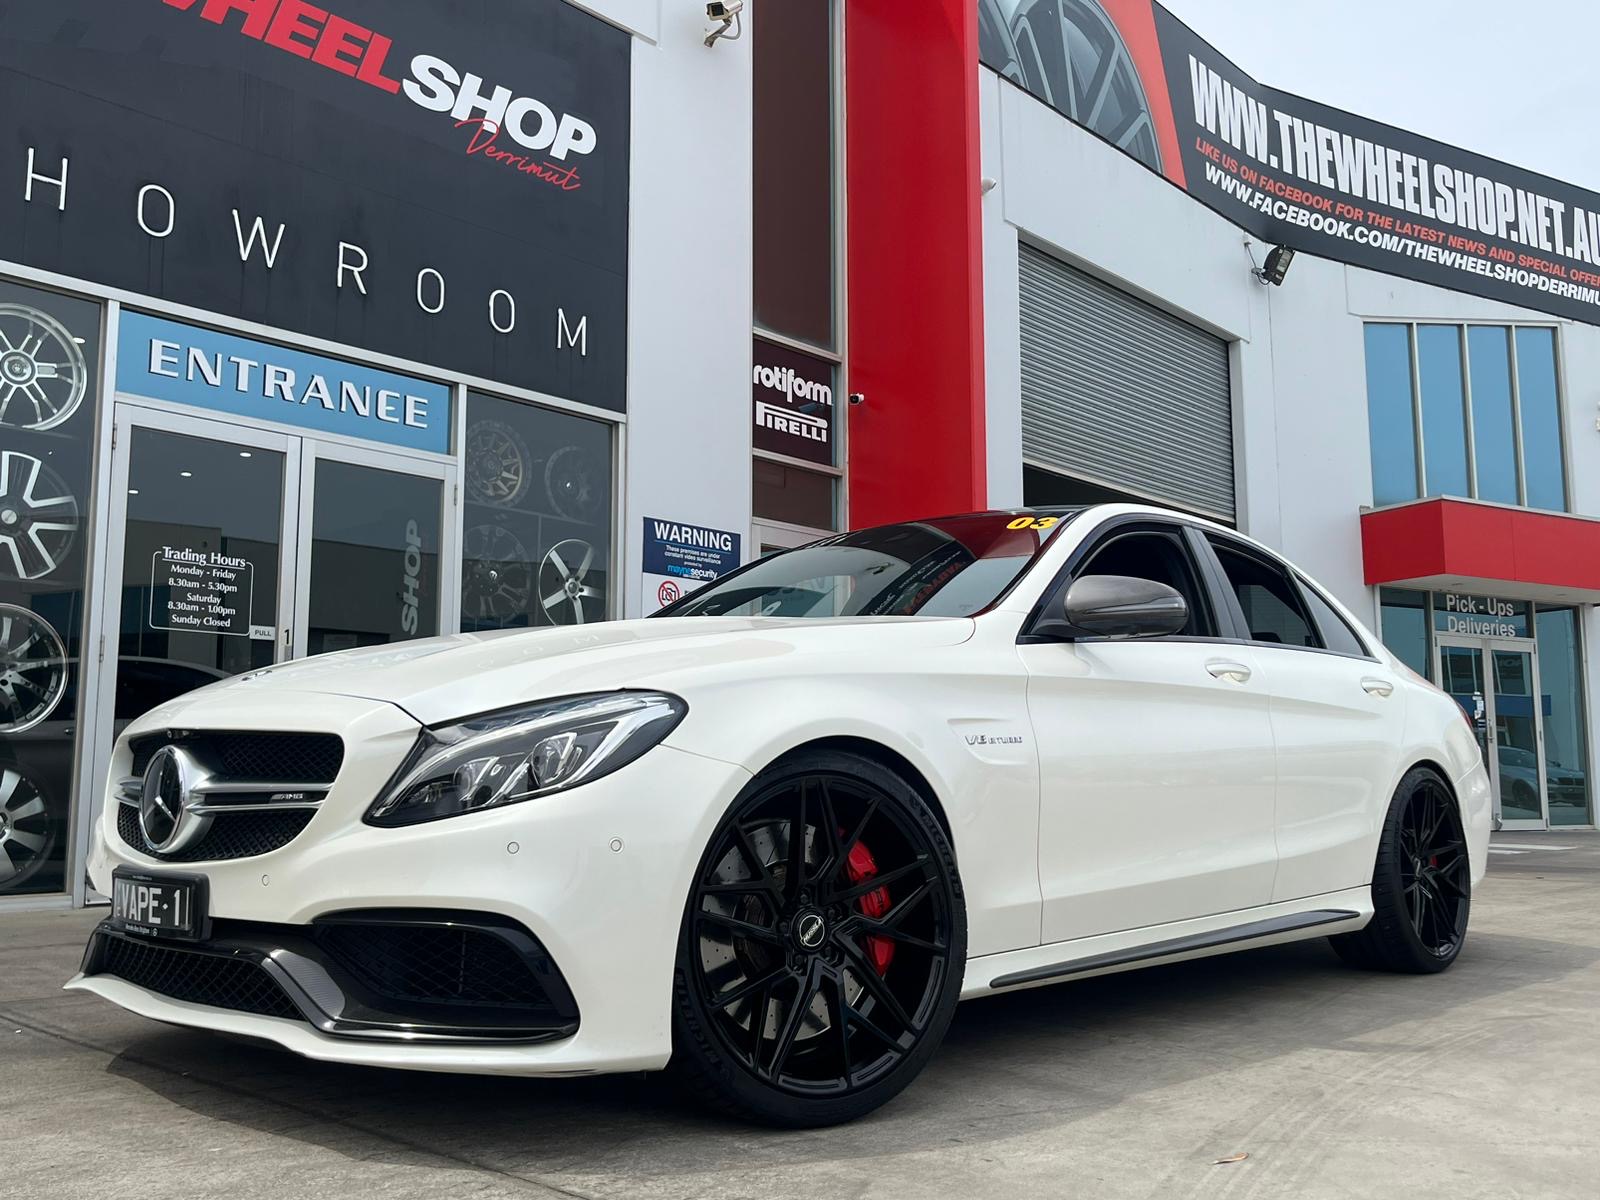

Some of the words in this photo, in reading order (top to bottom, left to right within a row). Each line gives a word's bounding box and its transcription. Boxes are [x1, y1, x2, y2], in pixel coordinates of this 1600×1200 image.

[454, 118, 580, 190] Derrimut
[1196, 137, 1220, 162] LIKE
[1221, 154, 1238, 174] US
[1240, 165, 1258, 185] ON
[1259, 175, 1333, 214] FACEBOOK
[1335, 202, 1364, 222] FOR
[1367, 211, 1394, 230] THE
[1395, 220, 1446, 244] LATEST
[1447, 234, 1487, 256] NEWS
[1488, 246, 1516, 263] AND
[1518, 254, 1568, 278] SPECIAL
[149, 338, 429, 428] ENTRANCE
[753, 364, 832, 406] rotiform
[756, 400, 828, 443] PIRELLI
[1007, 517, 1058, 529] 03
[654, 521, 732, 551] WARNING
[162, 546, 207, 566] Trading
[210, 552, 246, 567] Hours
[171, 564, 205, 577] Monday
[212, 569, 236, 581] Friday
[402, 519, 421, 635] SHOP
[168, 577, 200, 588] 8.30am
[208, 581, 238, 593] 5.30pm
[168, 601, 199, 611] 8.30am
[208, 605, 236, 616] 1.00pm
[187, 592, 221, 605] Saturday
[1446, 594, 1477, 613] Pick
[1487, 598, 1514, 619] Ups
[171, 614, 202, 626] Sunday
[203, 616, 231, 627] Closed
[1447, 616, 1516, 637] Deliveries
